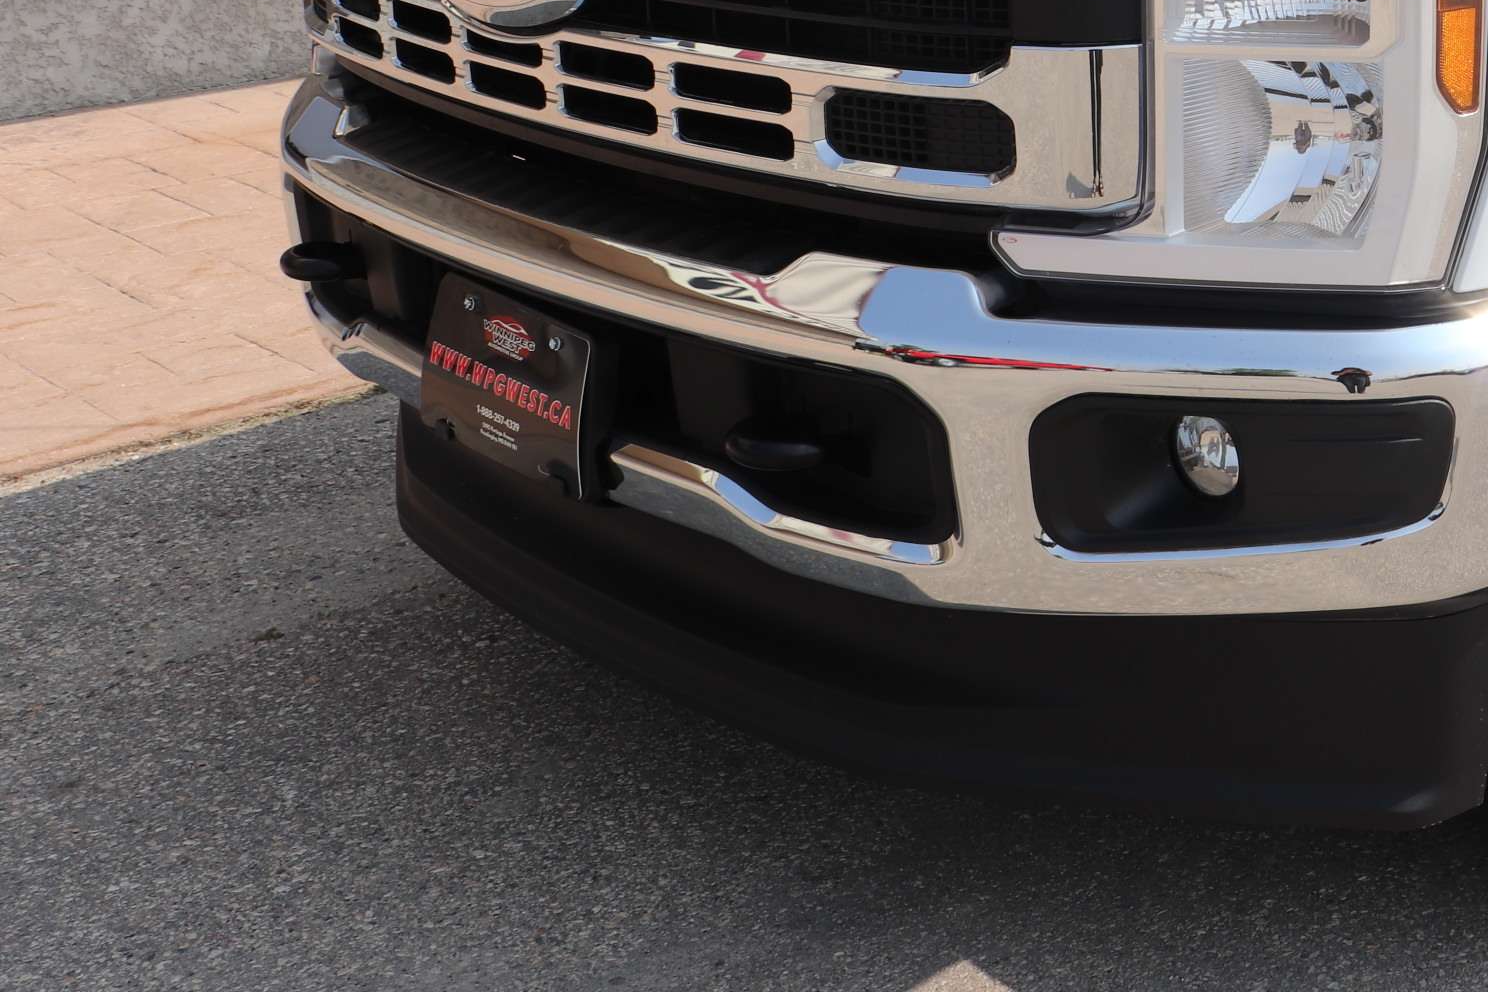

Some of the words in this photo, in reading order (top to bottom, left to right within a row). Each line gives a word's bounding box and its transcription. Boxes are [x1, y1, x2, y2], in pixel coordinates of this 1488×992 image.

[483, 318, 536, 352] WINNIPEG
[492, 331, 522, 354] WEST
[430, 340, 571, 430] WWW.WPGWEST.CA
